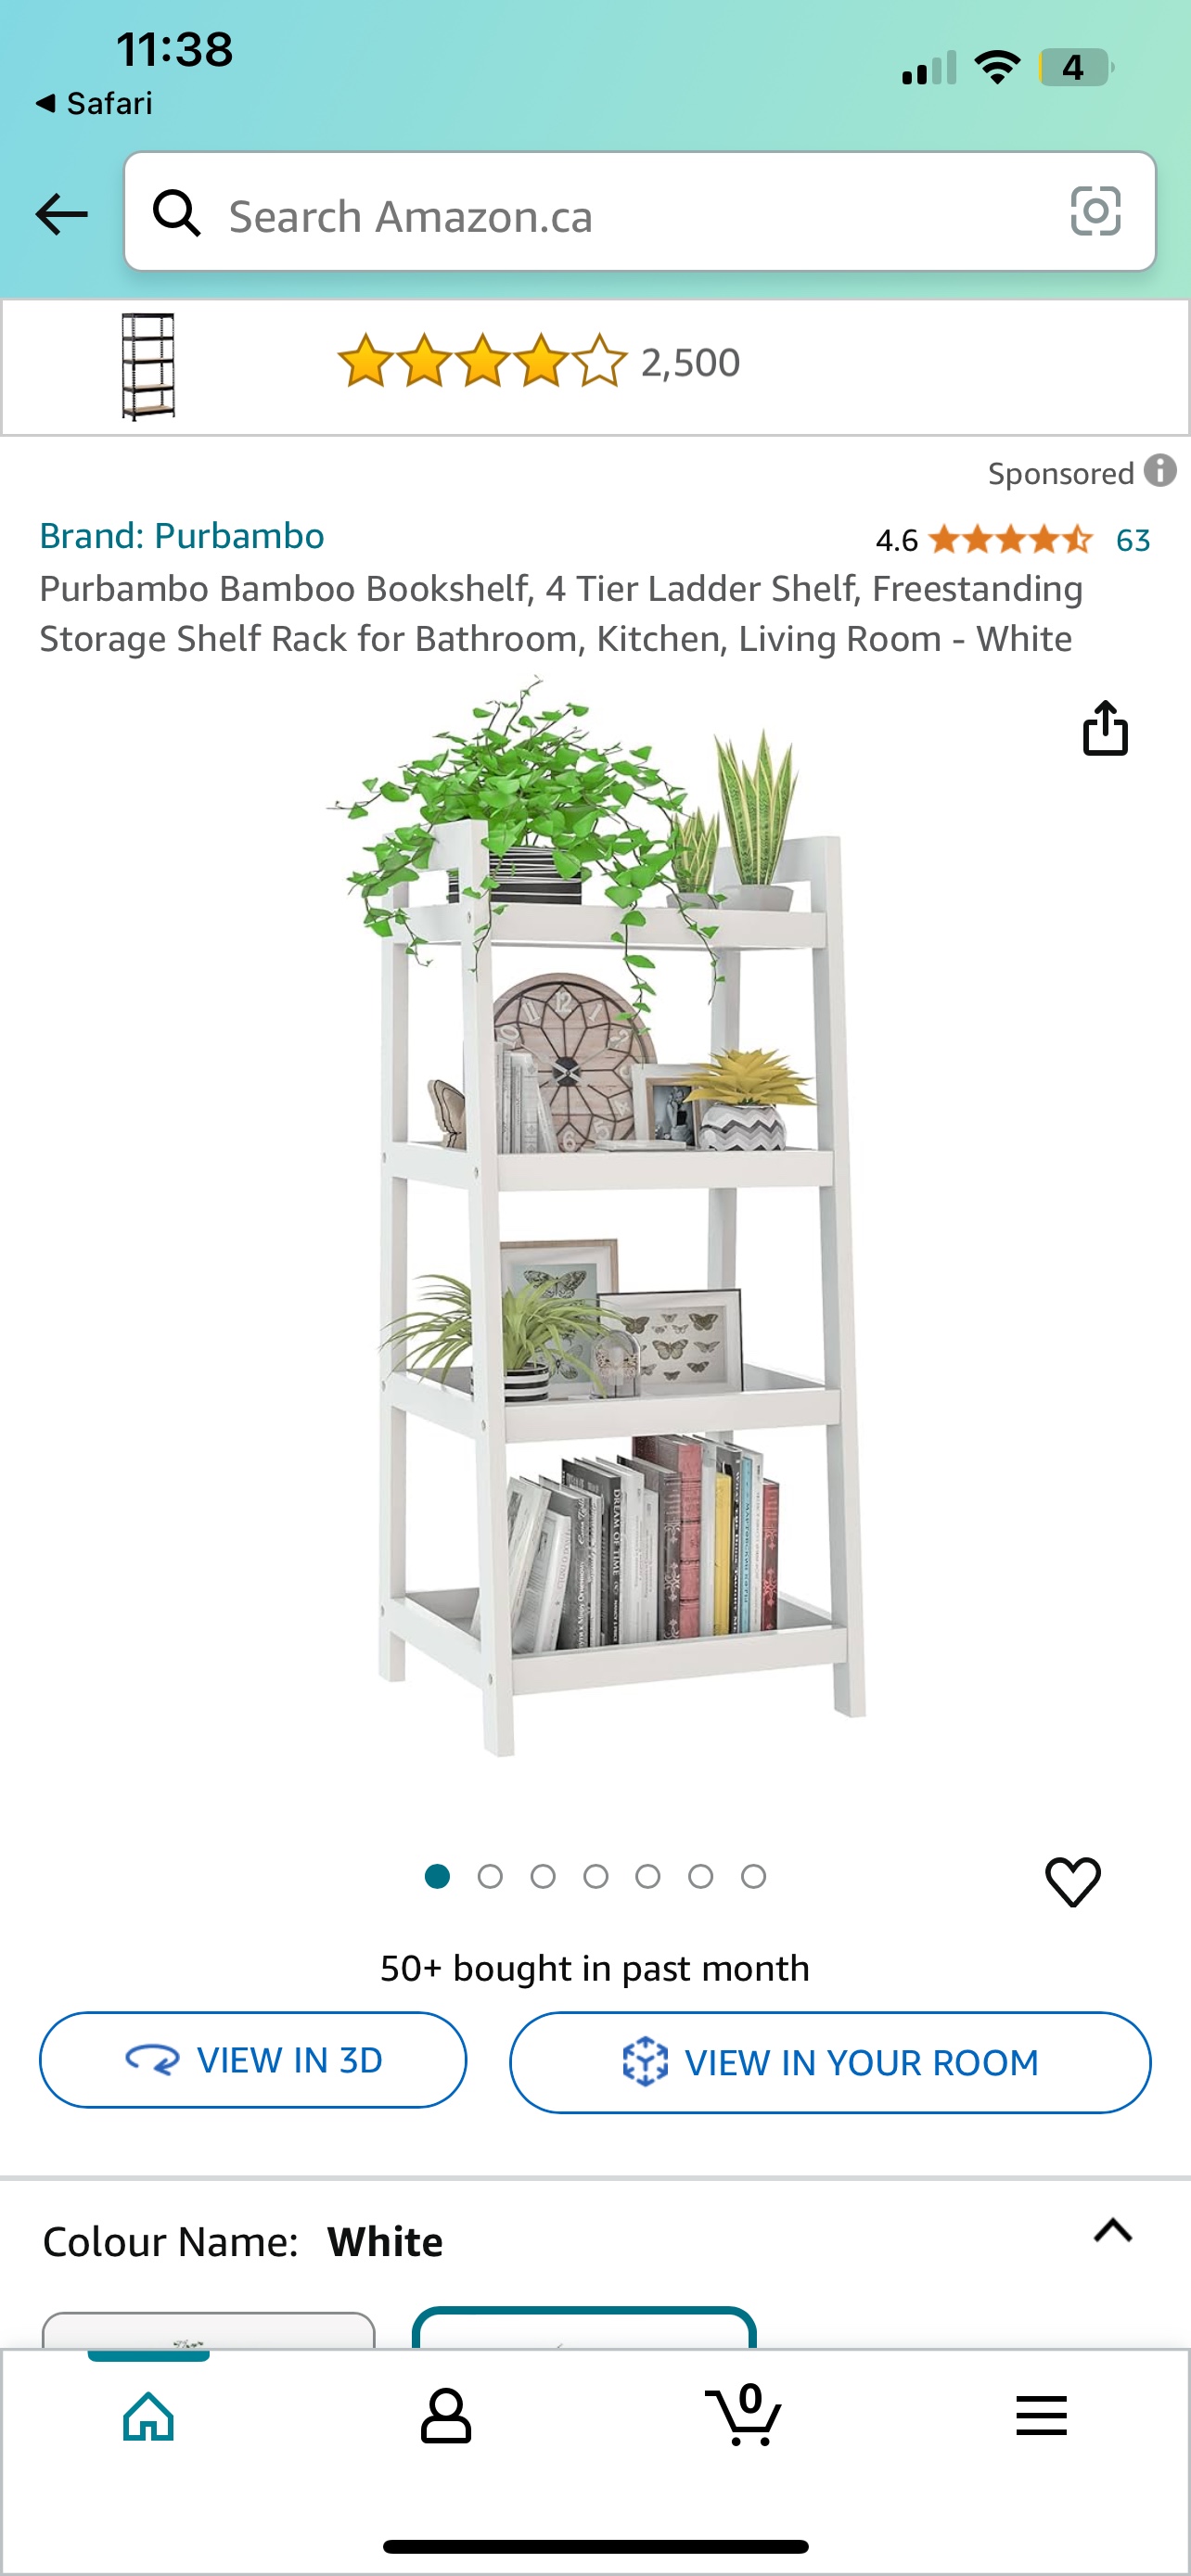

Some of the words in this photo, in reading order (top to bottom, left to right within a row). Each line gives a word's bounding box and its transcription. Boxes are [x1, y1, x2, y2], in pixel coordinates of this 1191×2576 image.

[117, 32, 233, 68] 11:38
[1062, 54, 1084, 81] 4
[67, 90, 152, 116] Safari
[230, 198, 361, 234] Search
[375, 200, 592, 234] Amazon.ca
[642, 347, 740, 383] 2,500
[989, 460, 1134, 491] Sponsored
[41, 520, 144, 550] Brand:
[156, 520, 325, 550] Purbambo
[876, 528, 918, 553] 4.6
[1116, 528, 1151, 553] 63
[42, 574, 208, 602] Purbambo
[222, 574, 354, 602] Bamboo
[368, 573, 533, 607] Bookshelf,
[546, 576, 566, 601] 4
[576, 575, 638, 602] Tier
[650, 574, 761, 602] Ladder
[773, 573, 860, 607] Shelf,
[875, 574, 1082, 610] Freestanding
[41, 625, 165, 659] Storage
[178, 623, 262, 652] Shelf
[274, 624, 347, 652] Rack
[358, 624, 404, 652] for
[417, 624, 584, 657] Bathroom,
[599, 624, 726, 657] Kitchen,
[741, 625, 835, 659] Living
[849, 626, 940, 652] Room
[977, 624, 1071, 652] White
[556, 991, 572, 1012] 12
[562, 1130, 577, 1152] 6
[613, 1532, 621, 1548] OF
[380, 1954, 442, 1983] 50+
[455, 1953, 572, 1990] bought
[583, 1954, 610, 1982] in
[623, 1956, 691, 1989] past
[703, 1953, 809, 1983] month
[196, 2047, 284, 2073] VIEW
[295, 2047, 327, 2073] IN
[339, 2047, 383, 2074] 3D
[684, 2049, 772, 2076] VIEW
[783, 2049, 815, 2076] IN
[826, 2048, 922, 2077] YOUR
[934, 2048, 1038, 2077] ROOM
[44, 2224, 168, 2258] Colour
[180, 2226, 298, 2258] Name:
[327, 2224, 443, 2258] White
[739, 2383, 762, 2414] 0
